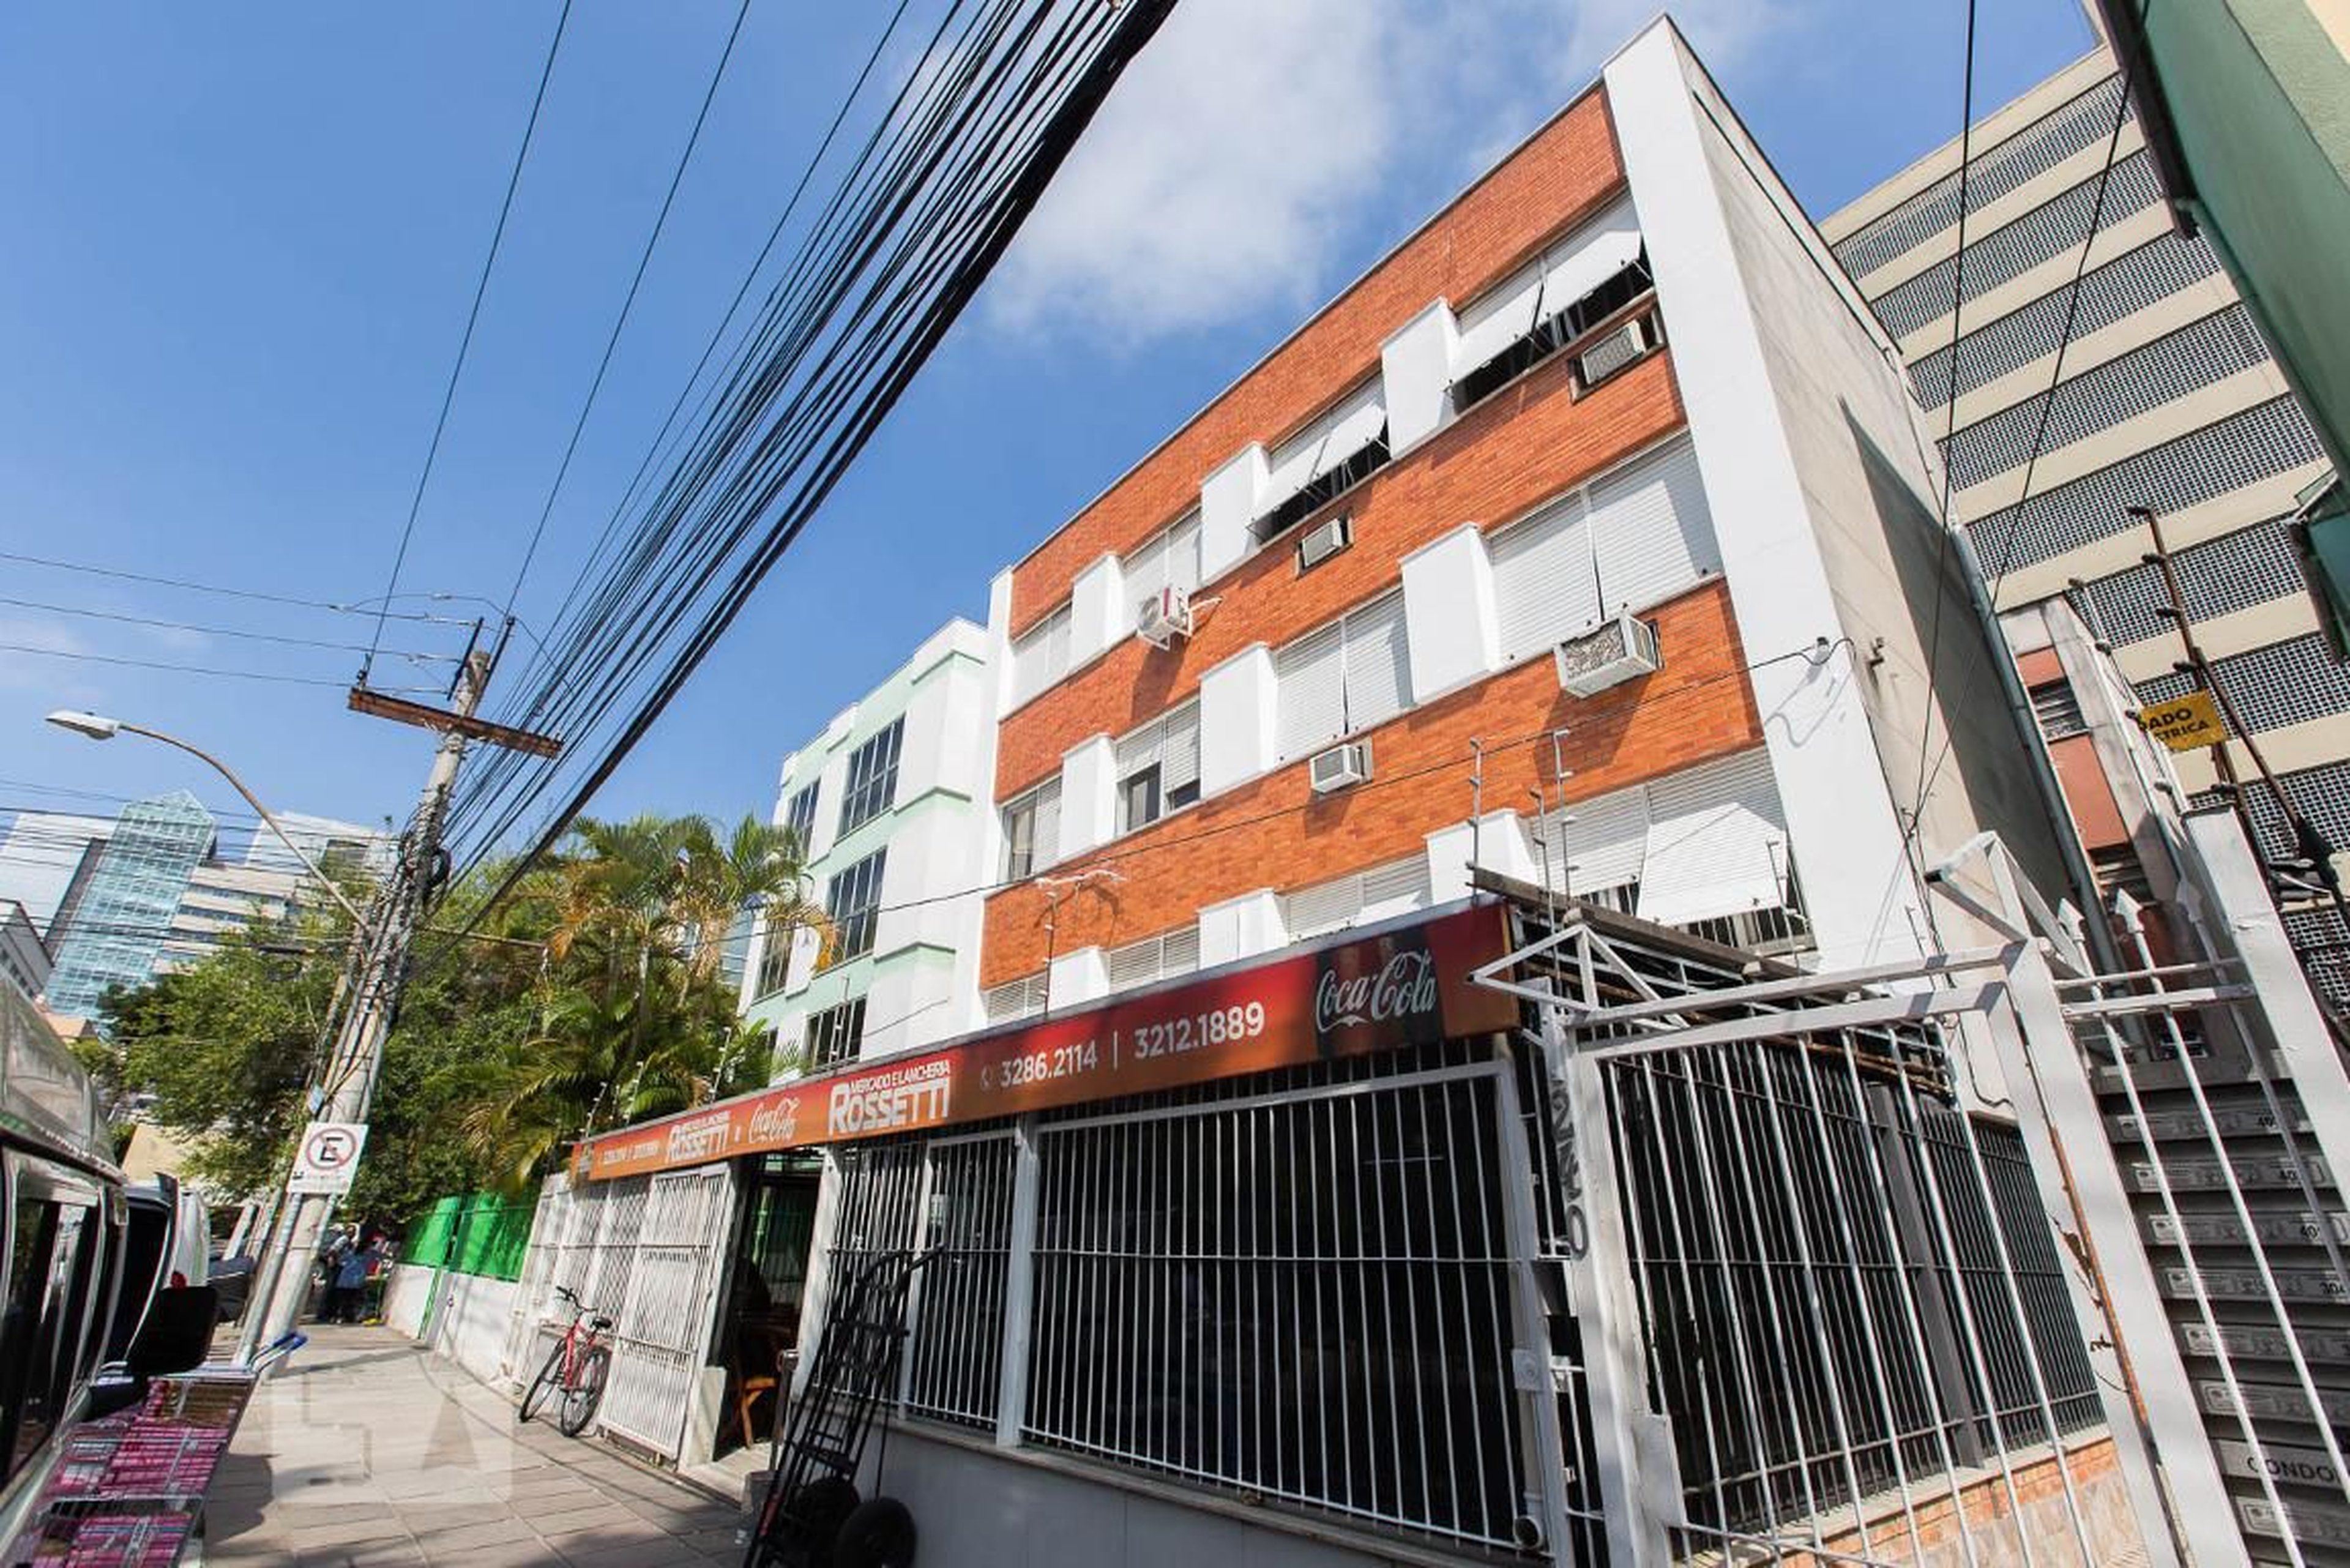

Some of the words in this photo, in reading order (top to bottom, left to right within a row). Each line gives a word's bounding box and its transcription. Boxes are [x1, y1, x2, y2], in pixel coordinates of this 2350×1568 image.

[1000, 1041, 1098, 1088] 3286.2114
[1134, 1001, 1266, 1059] 3212.1889
[829, 1077, 950, 1140] ROSSETTI
